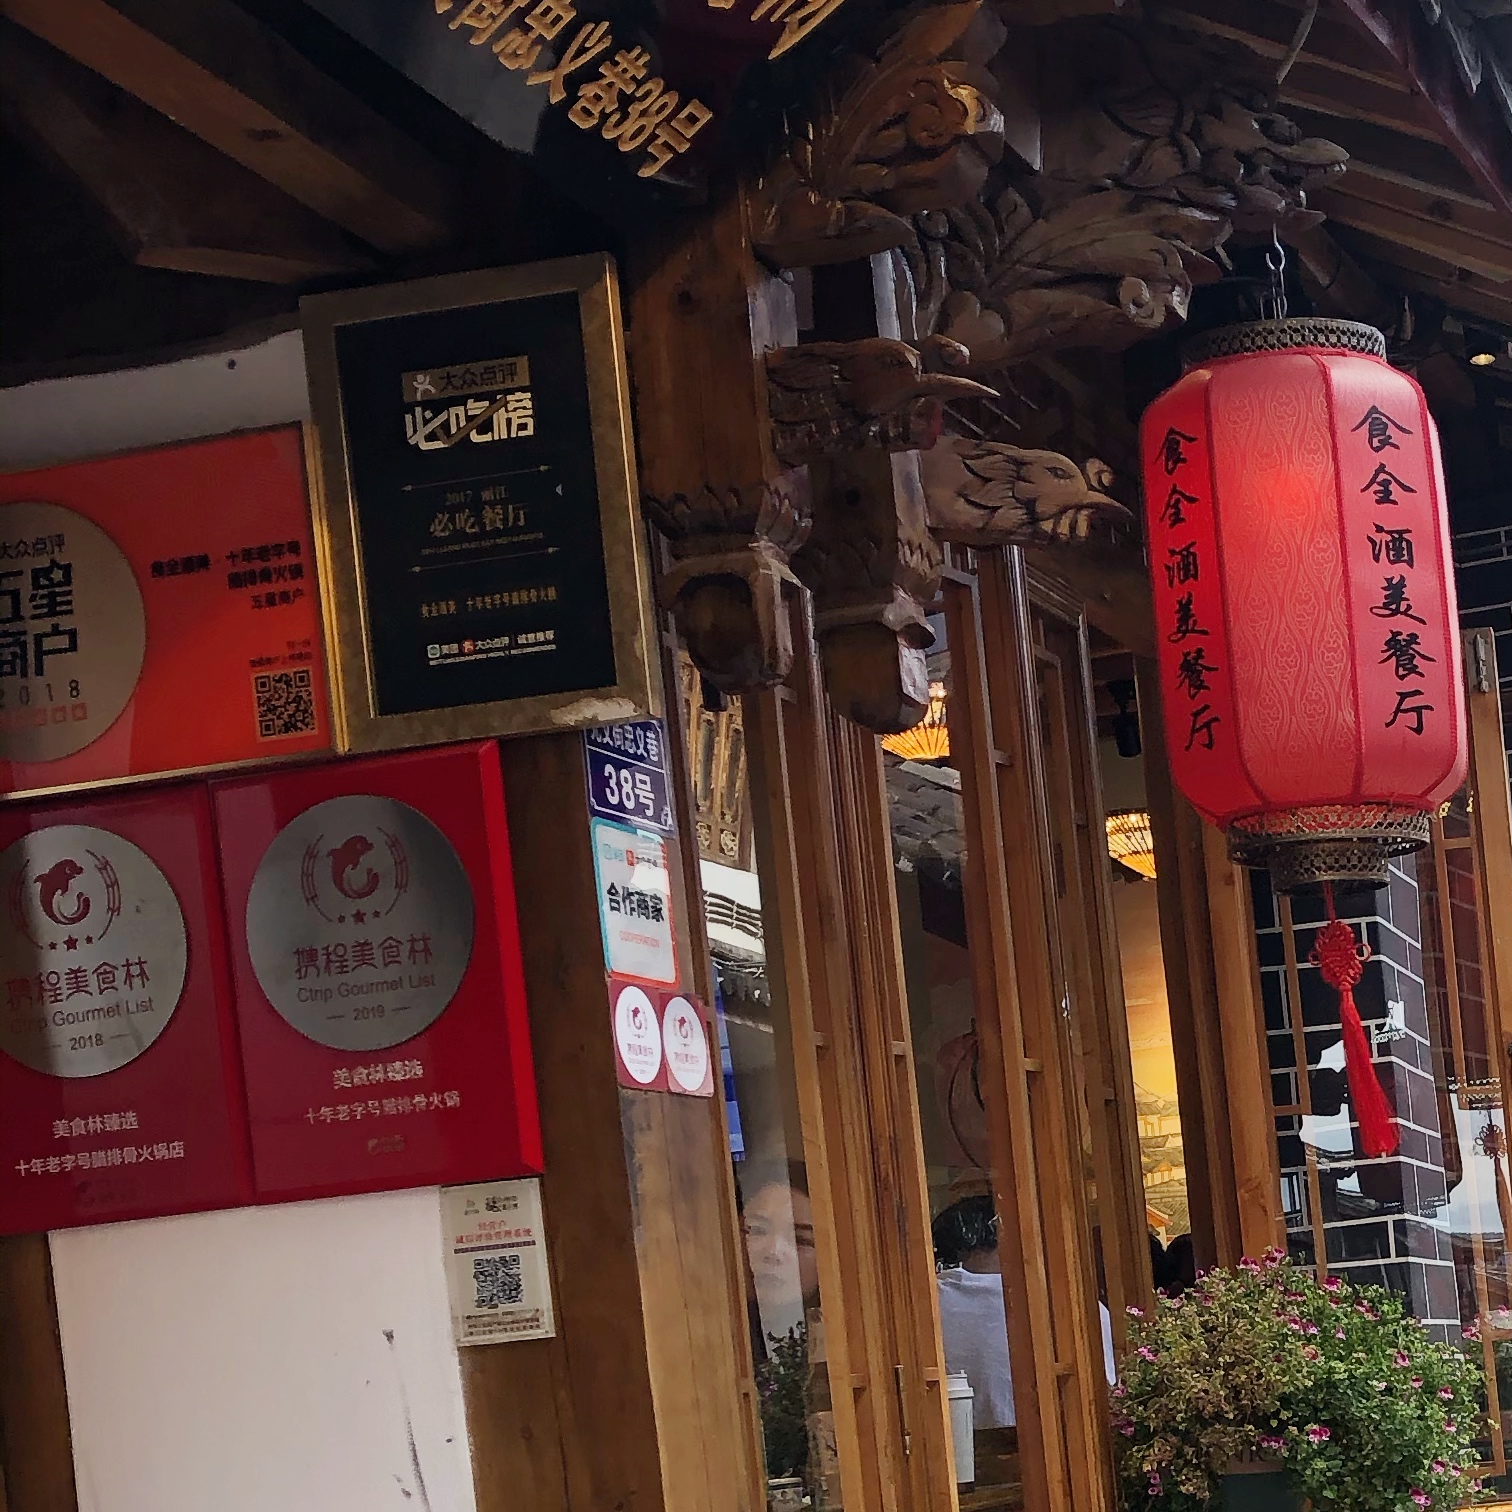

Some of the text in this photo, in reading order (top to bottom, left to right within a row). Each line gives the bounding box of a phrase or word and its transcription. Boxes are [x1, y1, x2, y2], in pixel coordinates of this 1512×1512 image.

[439, 364, 518, 391] 大众点评
[404, 391, 535, 450] 必吃榜
[429, 503, 528, 538] 必吃餐厅
[1350, 404, 1437, 736] 食全酒美餐厅
[1153, 427, 1221, 751] 食全酒美餐厅
[603, 763, 656, 817] 38号
[606, 881, 665, 923] 合作商家
[292, 932, 433, 981] 携程美食林
[7, 956, 151, 1010] 携程美食林
[297, 972, 436, 1003] Ctrip Gourmet List
[52, 1004, 123, 1027] Gourmet
[125, 996, 155, 1015] List
[353, 1004, 386, 1021] 2019
[69, 1033, 104, 1051] 2018
[332, 1058, 424, 1089] 美食林臻选
[52, 1110, 139, 1138] 美食林臻选
[304, 1089, 462, 1125] 十年老字号腊排骨火锅
[15, 1140, 185, 1176] 十年老字号腊排骨火锅店
